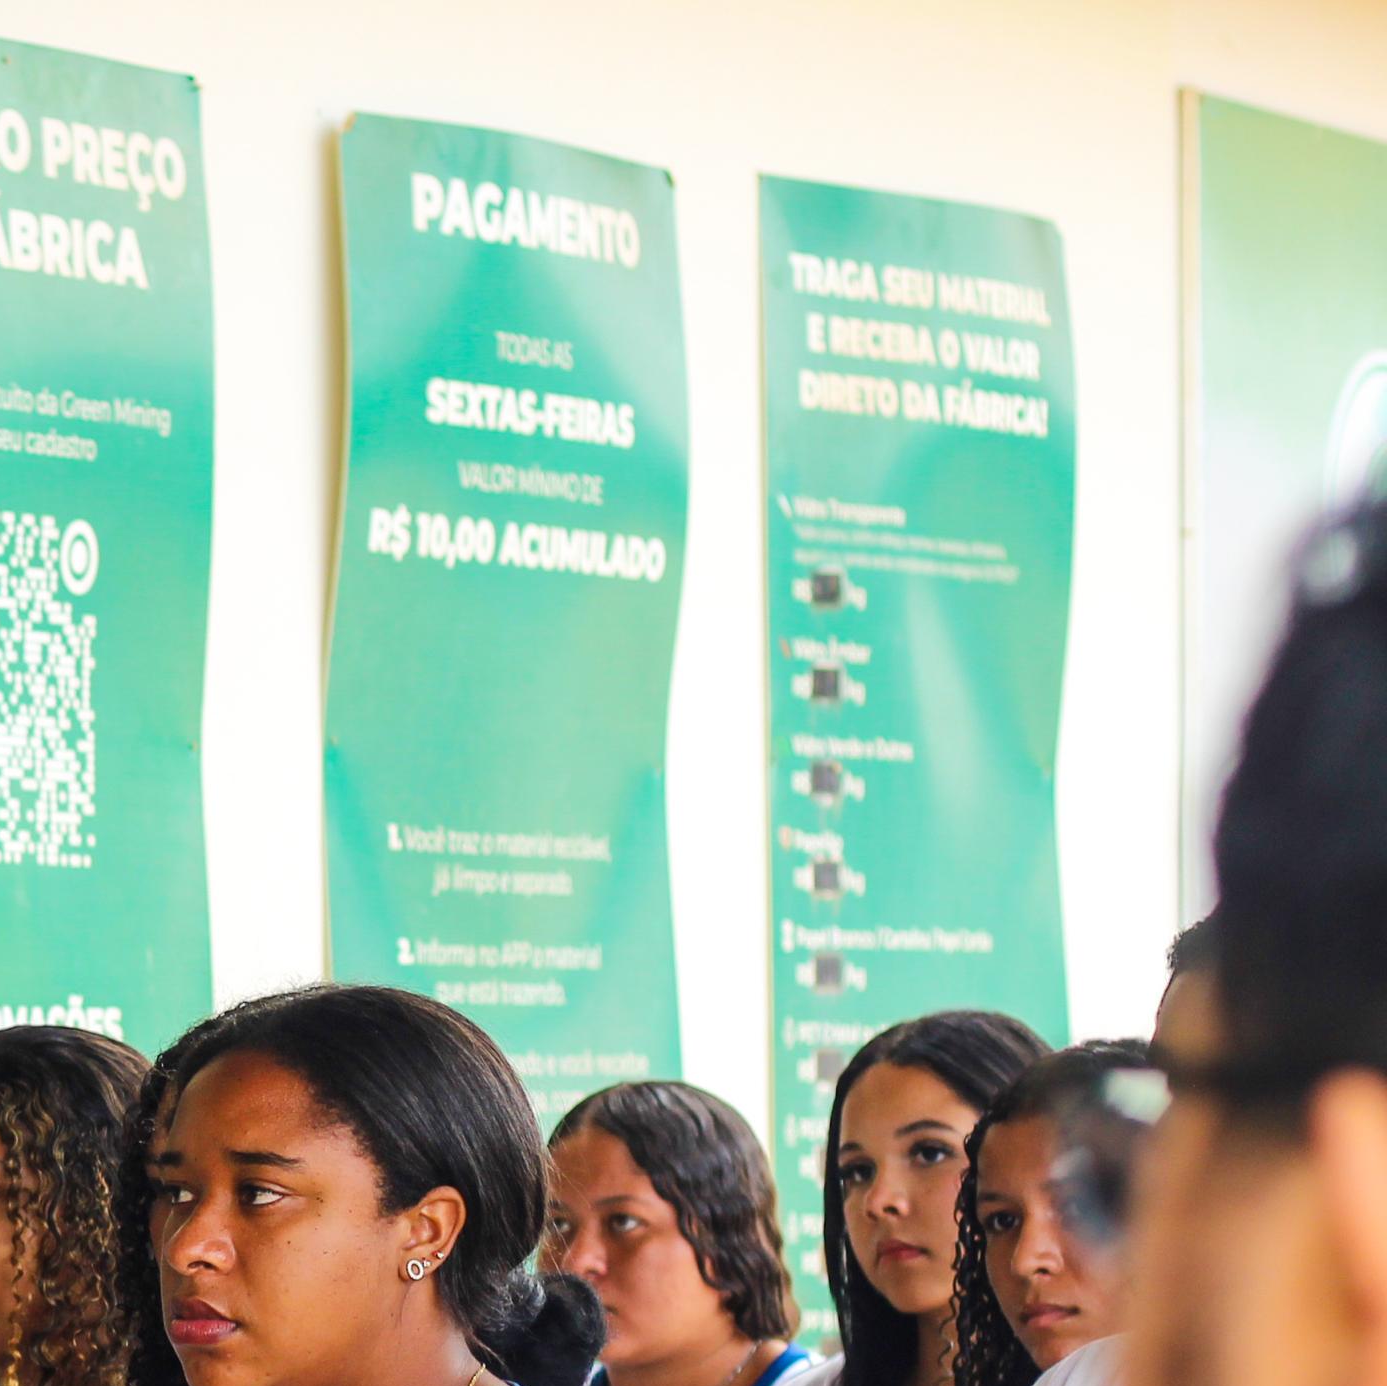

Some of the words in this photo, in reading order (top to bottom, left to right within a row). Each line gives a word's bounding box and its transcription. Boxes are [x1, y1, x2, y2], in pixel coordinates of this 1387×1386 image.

[41, 117, 187, 212] PREÇO
[411, 171, 641, 268] PAGAMENTO
[788, 250, 881, 303] TRAGA
[882, 263, 935, 310] SEU
[939, 271, 1052, 330] MATERIAL
[807, 311, 826, 354] E
[828, 314, 937, 368] RECEBA
[939, 327, 961, 370] O
[962, 331, 1041, 383] VALOR
[36, 387, 59, 417] da
[61, 390, 112, 424] Green
[113, 397, 172, 438] Mining
[426, 376, 635, 448] SEXTAS-FEIRAS
[798, 368, 899, 419] DIRETO
[901, 379, 943, 424] DA
[943, 378, 1048, 439] FÁBRICA!
[25, 428, 98, 462] cadastro
[368, 503, 412, 562] R$
[416, 510, 496, 570] 10,00
[498, 521, 667, 583] ACUMULADO
